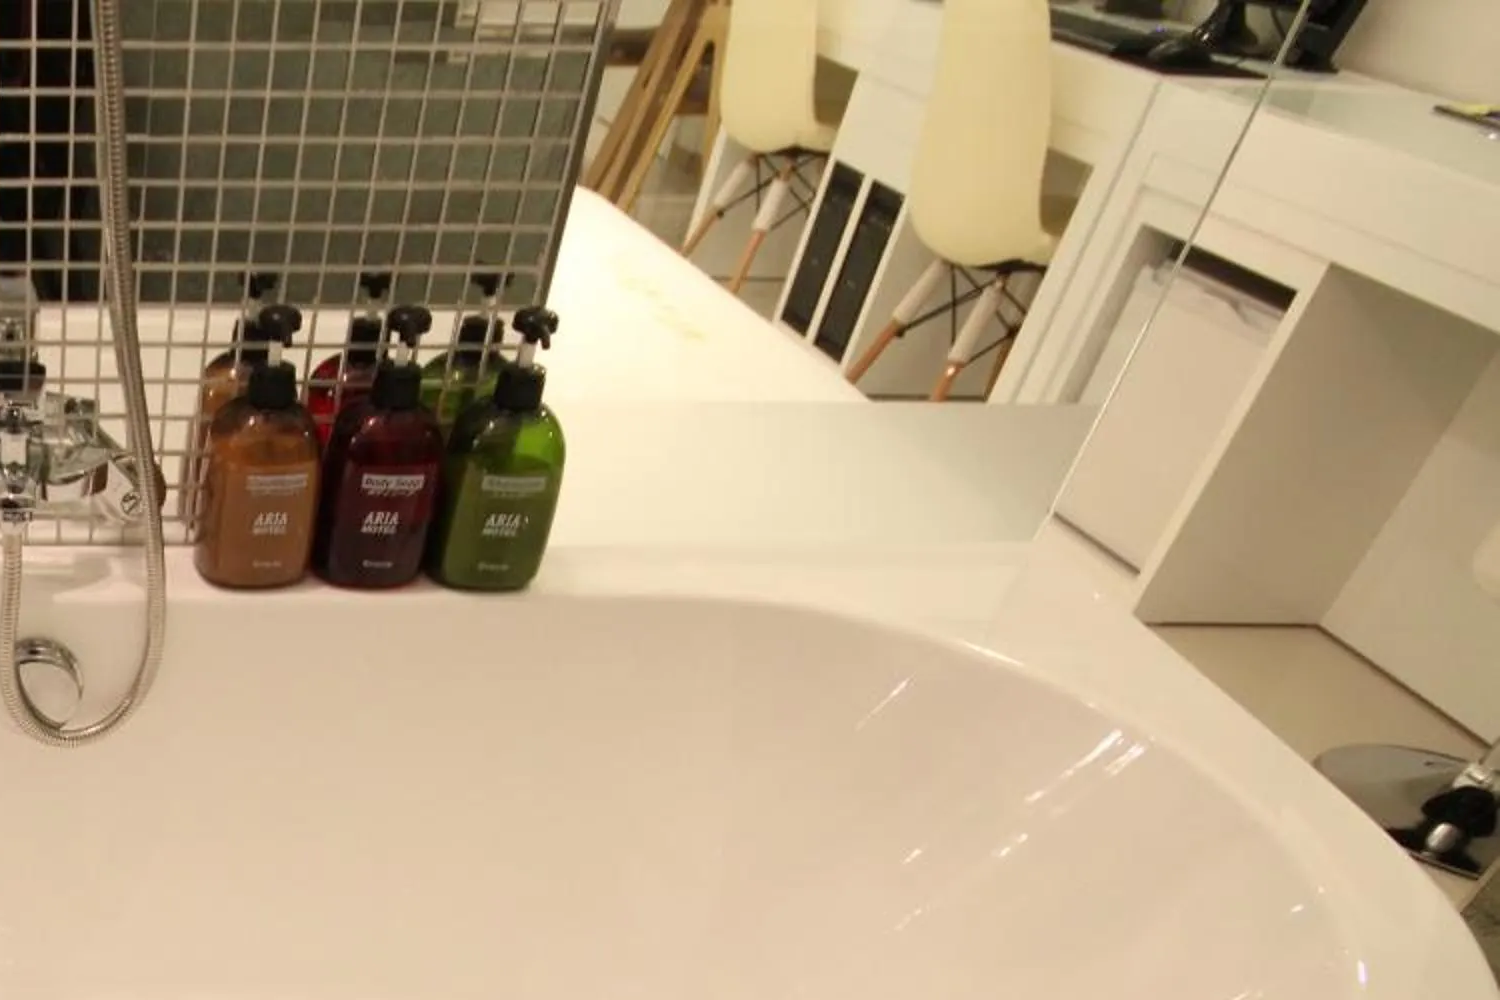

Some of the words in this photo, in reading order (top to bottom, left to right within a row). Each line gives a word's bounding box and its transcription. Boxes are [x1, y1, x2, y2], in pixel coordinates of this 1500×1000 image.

[365, 477, 391, 488] Body
[253, 511, 288, 525] ARIA
[364, 511, 399, 525] ARIA
[484, 513, 521, 527] ARIA
